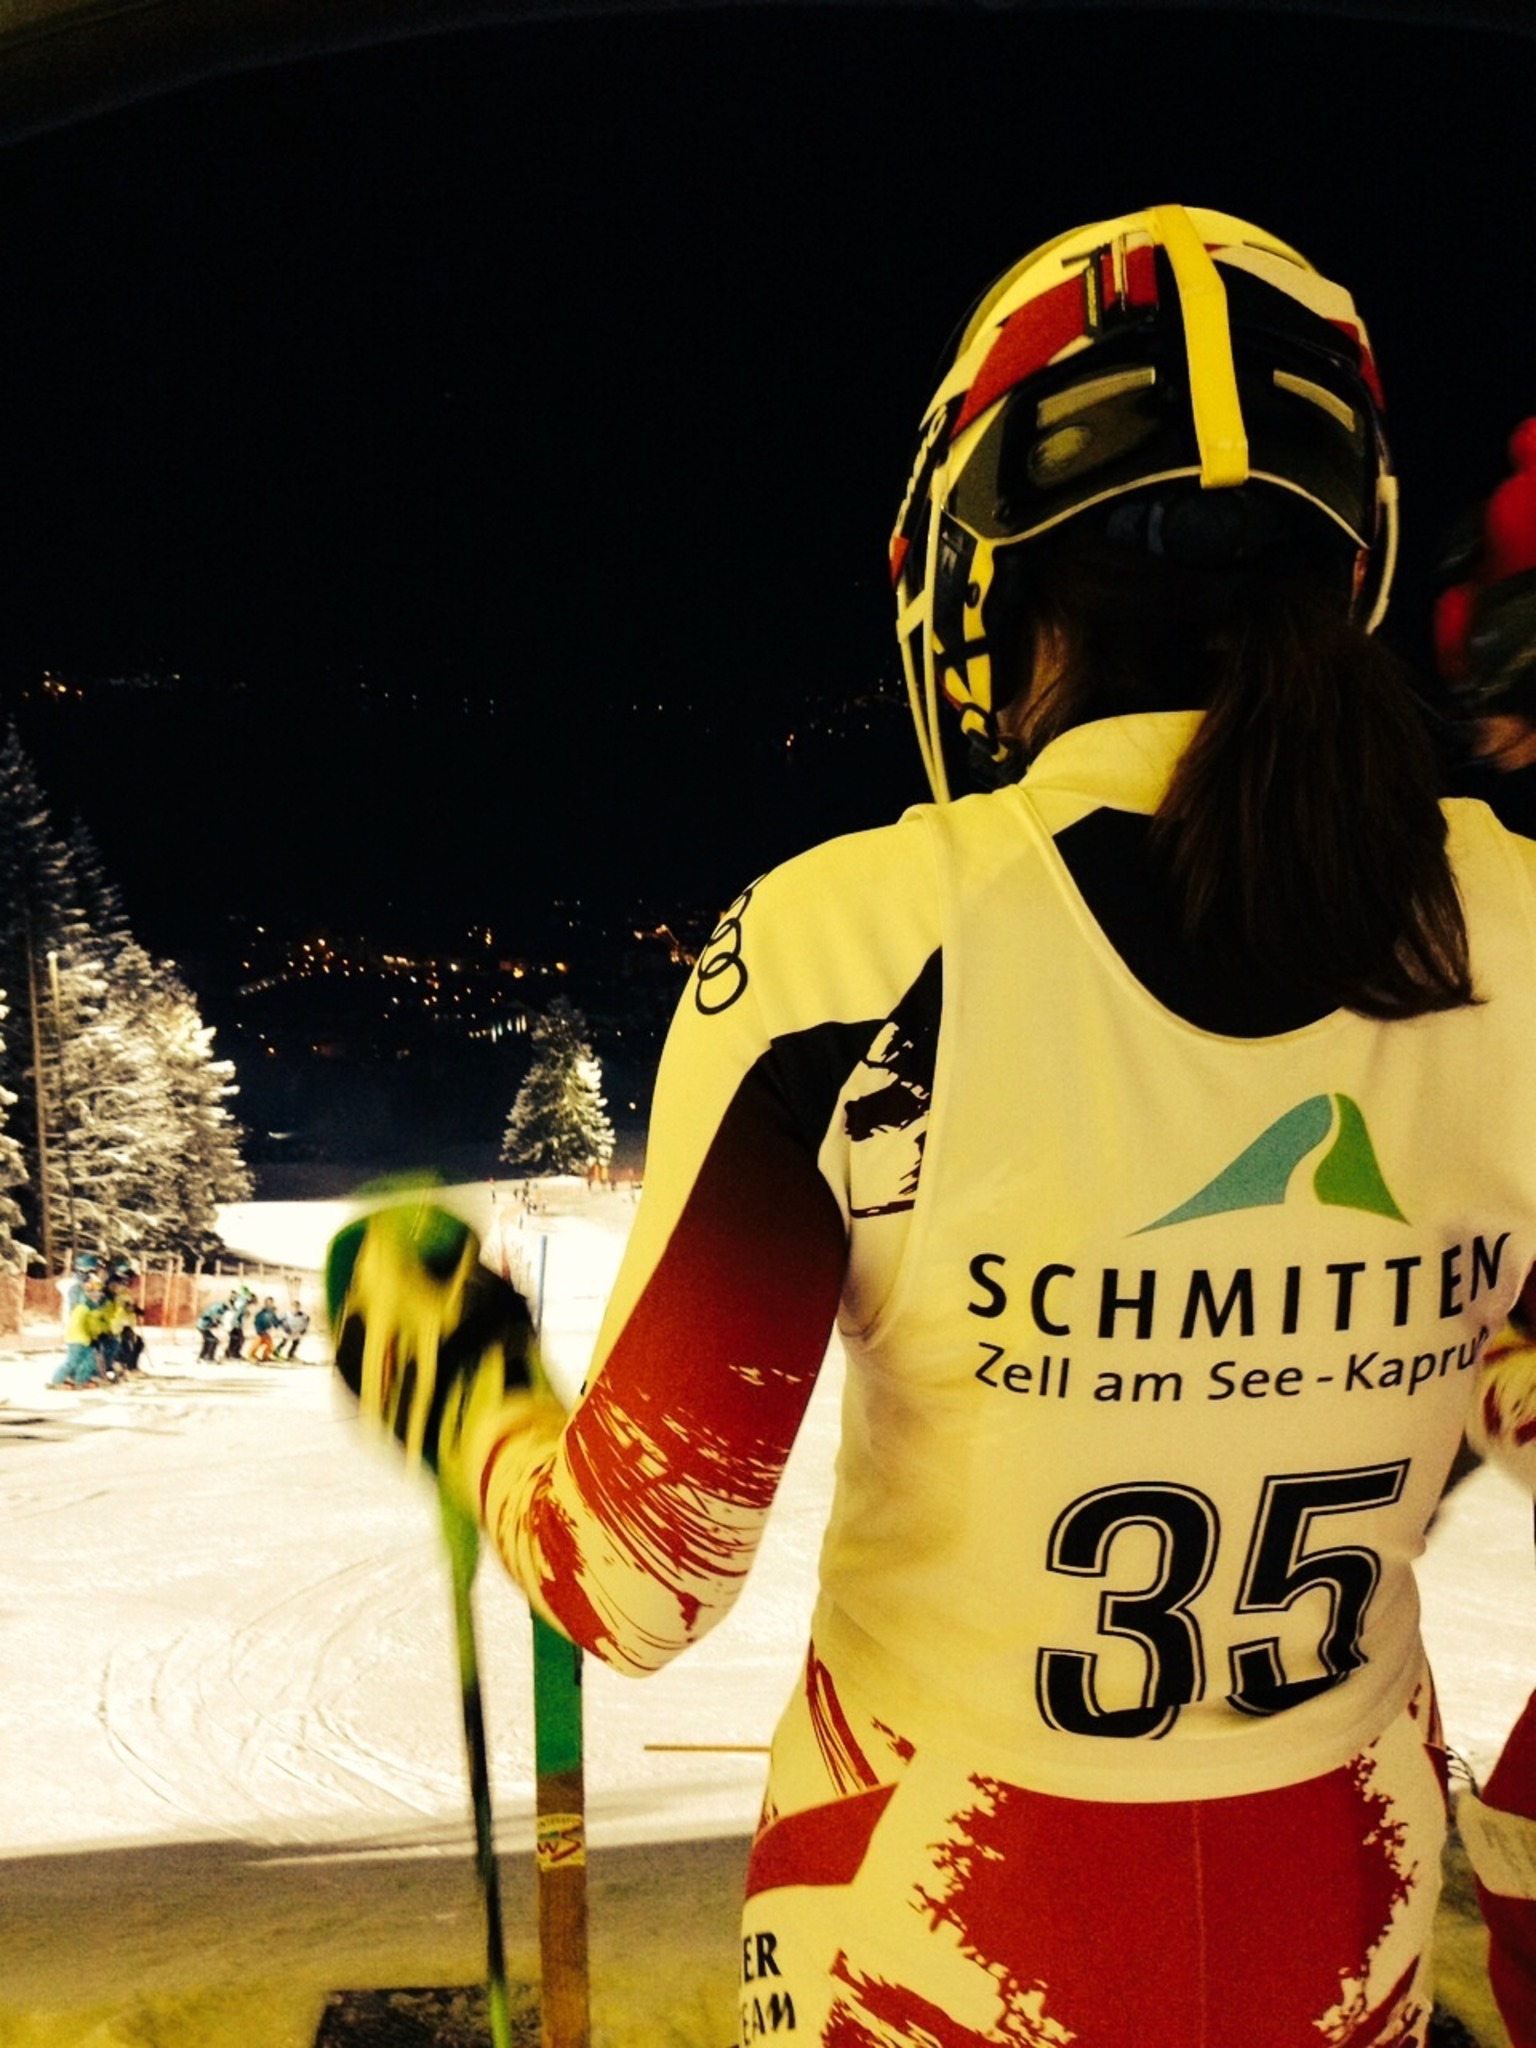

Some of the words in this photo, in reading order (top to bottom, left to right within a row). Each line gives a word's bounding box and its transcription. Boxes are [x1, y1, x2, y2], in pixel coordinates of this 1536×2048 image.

[967, 1232, 1512, 1340] SCHMITTEN
[975, 1341, 1071, 1398] Zell
[1094, 1372, 1182, 1402] am
[1034, 1457, 1412, 1741] 35
[743, 1931, 782, 1982] ER
[742, 1991, 797, 2046] EAM
